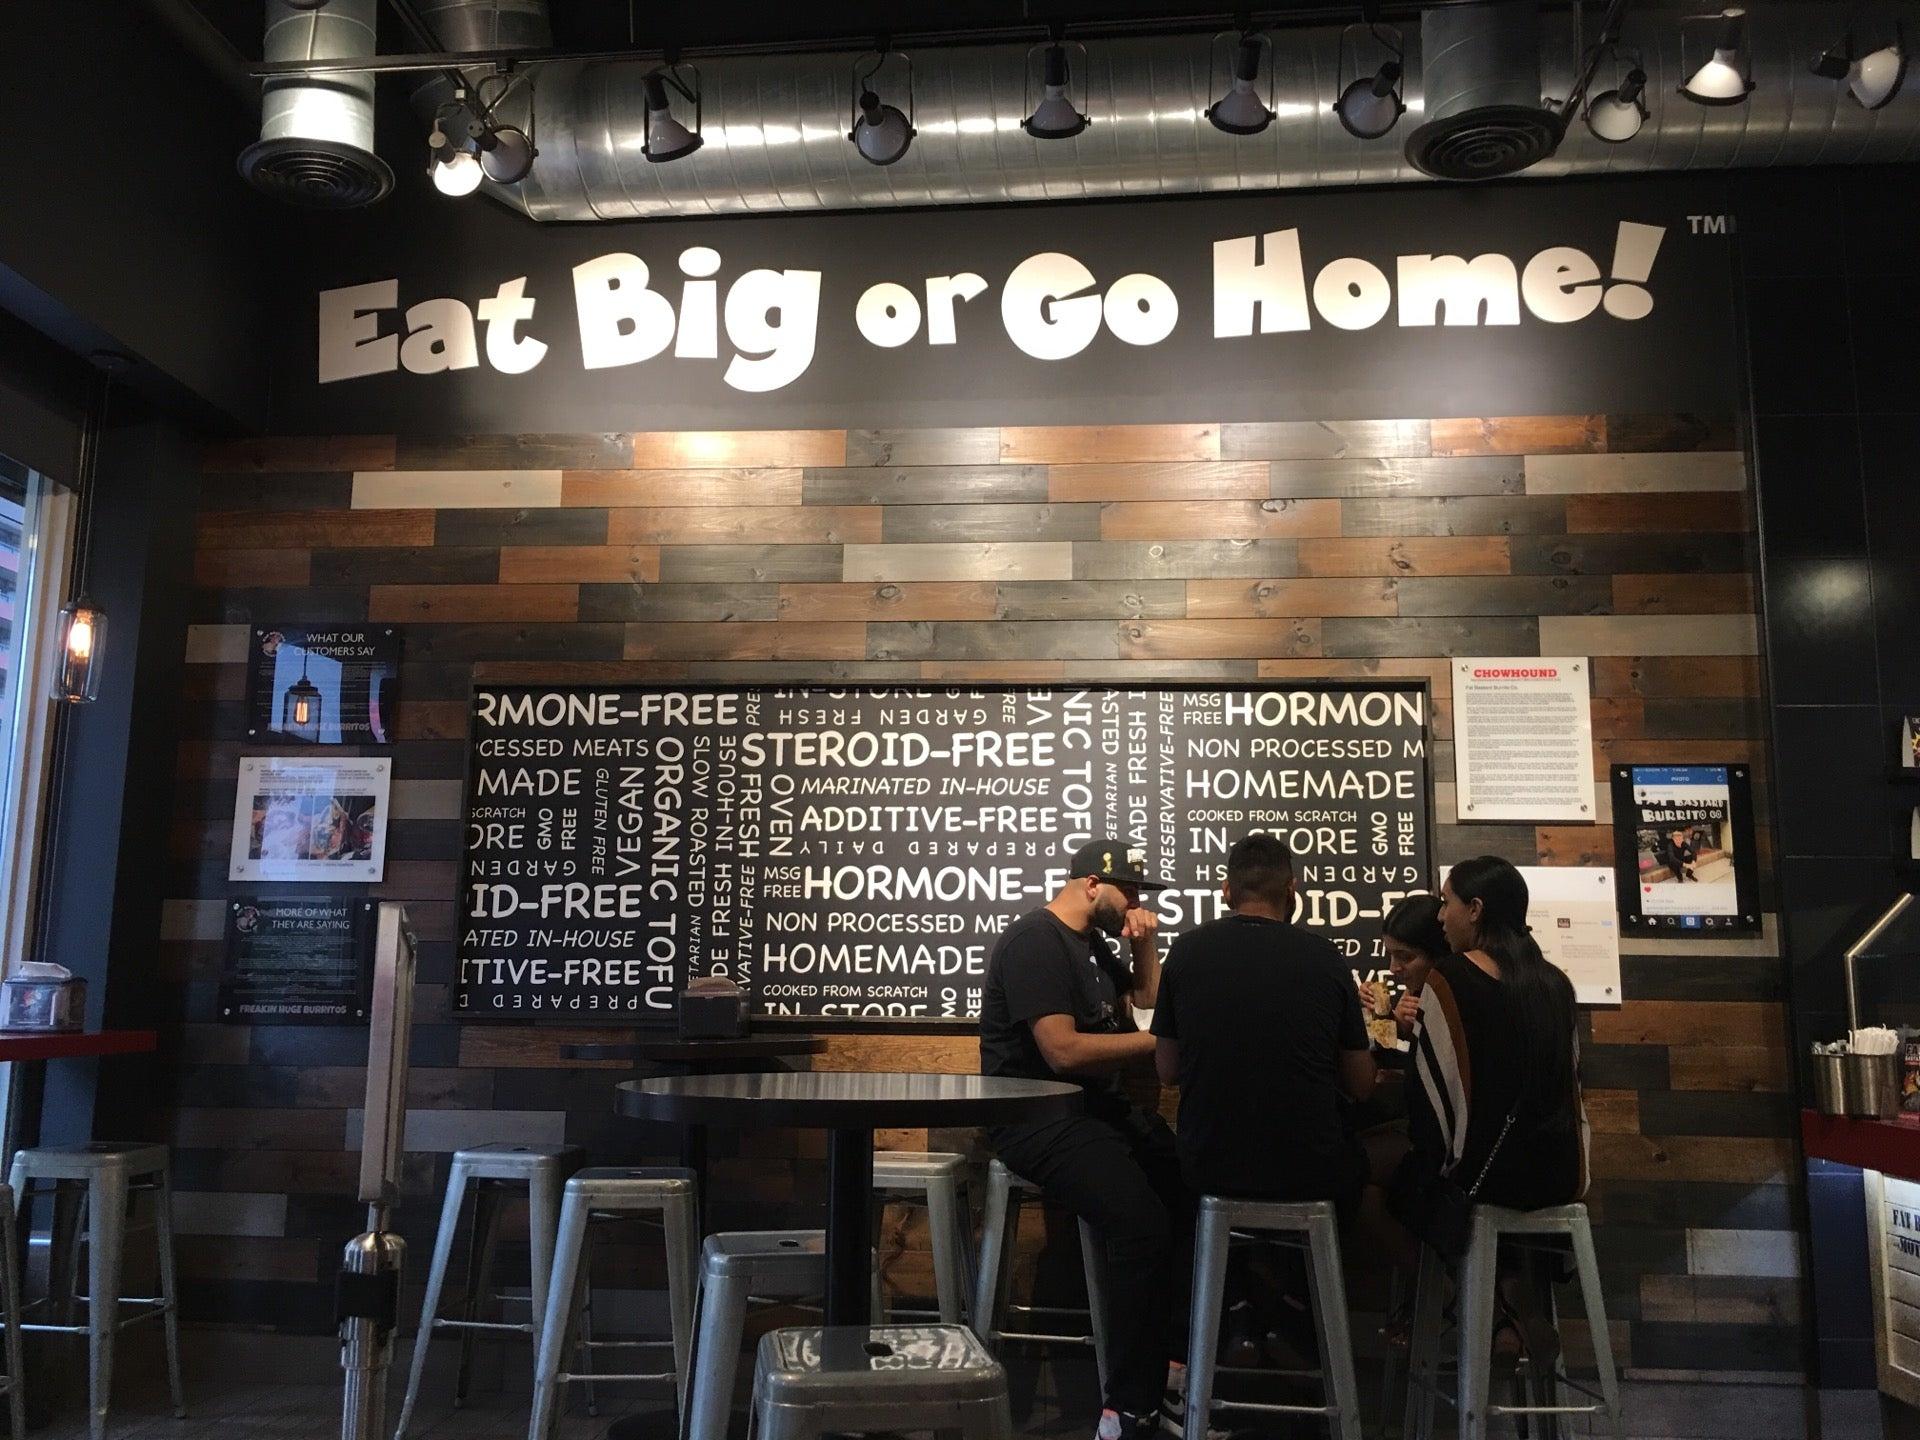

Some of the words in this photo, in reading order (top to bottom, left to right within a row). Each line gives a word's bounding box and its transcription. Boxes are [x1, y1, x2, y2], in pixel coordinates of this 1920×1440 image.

[1687, 216, 1725, 234] TM
[319, 277, 548, 383] Eat
[573, 247, 821, 392] Big
[856, 273, 988, 347] or
[1001, 253, 1178, 360] Go
[1213, 222, 1665, 340] Home!
[306, 633, 338, 643] WHAT
[341, 633, 364, 643] OUR
[294, 647, 355, 656] CUSTOMERS
[357, 646, 375, 656] SAY
[1473, 669, 1557, 677] CHOWHOUND
[1182, 692, 1221, 707] MSG
[1225, 692, 1423, 726] HORMON
[780, 710, 860, 725] FRESH
[881, 709, 987, 725] GARDEN
[1184, 711, 1222, 724] FREE
[476, 738, 564, 757] CESSED
[573, 739, 649, 756] MEATS
[742, 730, 1055, 767] STEROID-FREE
[1128, 711, 1147, 784] FRESH
[1188, 739, 1239, 758] NON
[1251, 739, 1392, 758] PROCESSED
[692, 736, 710, 797] SLOW
[478, 768, 581, 796] MADE
[716, 736, 736, 851] IN-HOUSE
[801, 777, 930, 795] MARINATED
[940, 778, 1051, 795] IN-HOUSE
[1159, 692, 1175, 881] PRESERVATIVE-FREE
[1187, 769, 1415, 799] HOMEMADE
[594, 768, 609, 830] GLUTEN
[615, 767, 645, 876] VEGAN
[650, 737, 684, 901] ORGANIC
[739, 774, 762, 857] FRESH
[769, 774, 794, 856] OVEN
[801, 806, 1057, 833] ADDITIVE-FREE
[1188, 810, 1243, 821] COOKED
[1249, 810, 1288, 821] FROM
[1295, 810, 1357, 822] SCRATCH
[1641, 809, 1706, 822] BURRITO
[537, 808, 553, 850] GMO
[561, 809, 576, 850] FREE
[1371, 812, 1388, 855] GMO
[1398, 812, 1414, 855] FREE
[592, 836, 606, 875] FREE
[688, 808, 709, 907] ROASTED
[800, 841, 883, 854] DAILY
[909, 842, 1055, 856] PREPARED
[472, 860, 576, 876] GARDEN
[764, 867, 800, 880] MSG
[1304, 866, 1417, 883] GARDEN
[764, 885, 801, 897] FREE
[805, 865, 1071, 903] HORMONE-F
[471, 882, 642, 918] ID-FREE
[712, 864, 732, 936] FRESH
[272, 920, 294, 929] THEY
[296, 920, 314, 929] ARE
[316, 920, 350, 929] SAYING
[275, 908, 302, 917] MORE
[304, 908, 317, 917] OF
[318, 908, 348, 917] WHAT
[767, 912, 817, 931] NON
[828, 912, 964, 933] PROCESSED
[975, 914, 1020, 933] ME
[464, 930, 517, 947] ATED
[527, 930, 635, 947] IN-HOUSE
[645, 913, 676, 1009] TOFU
[764, 943, 985, 975] HOMEMADE
[493, 995, 637, 1009] PREPARED
[763, 985, 817, 996] COOKED
[823, 985, 861, 997] FROM
[868, 986, 927, 997] SCRATCH
[240, 1004, 276, 1013] FREAKIN
[279, 1005, 302, 1014] HUGE
[303, 1005, 347, 1014] BURRITOS
